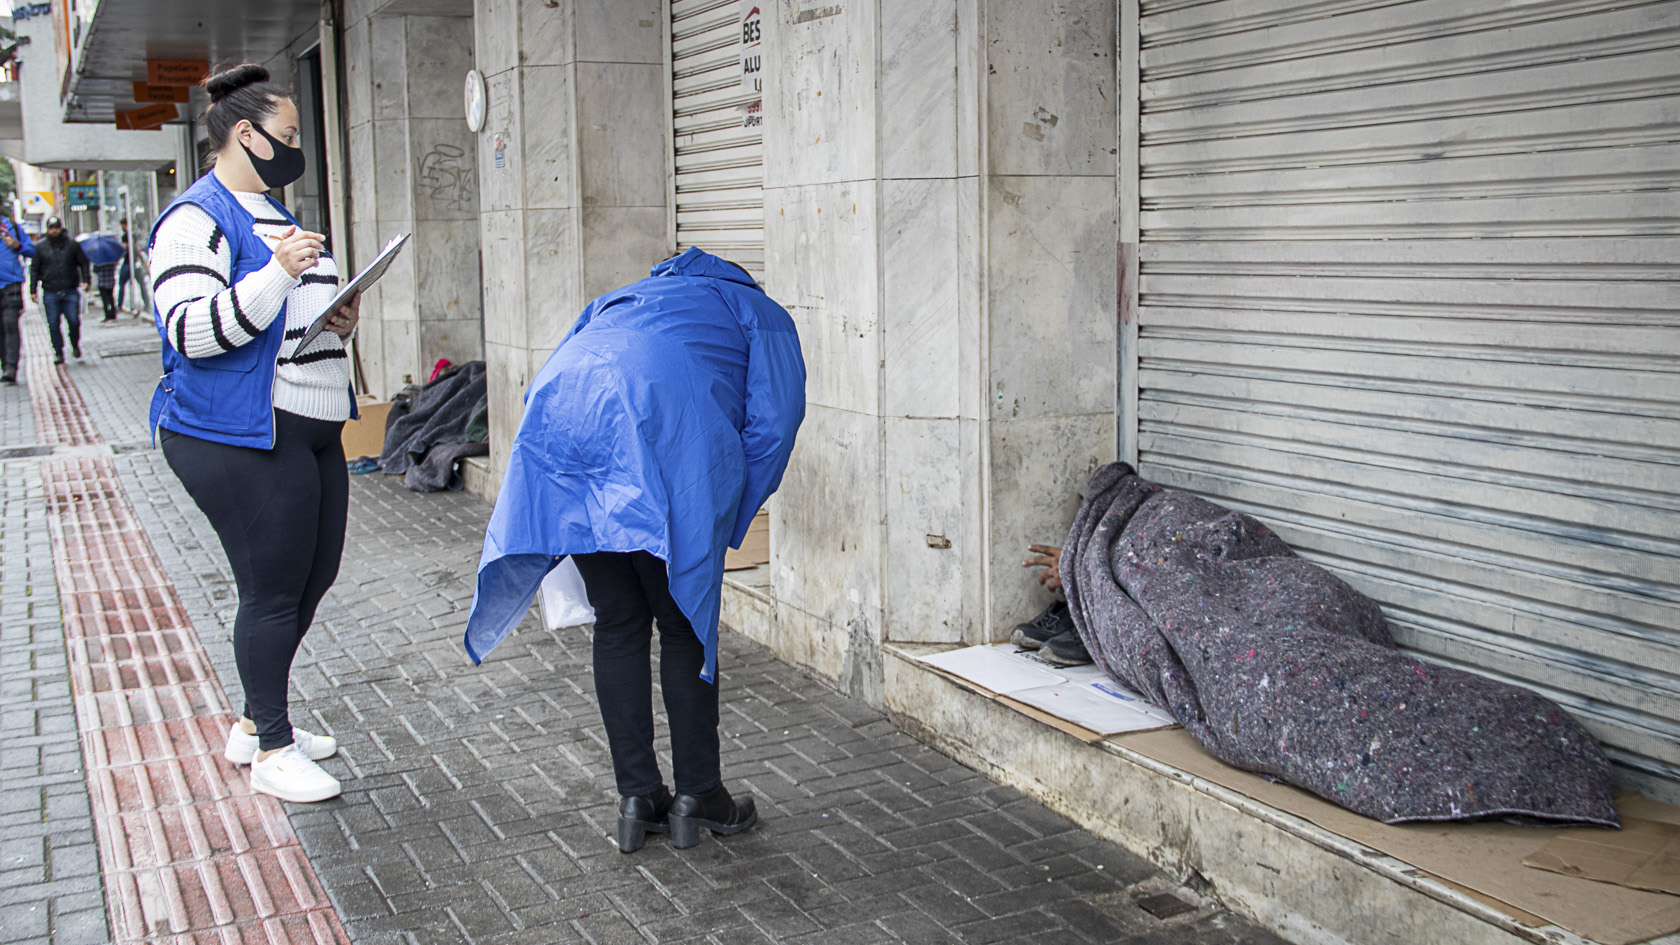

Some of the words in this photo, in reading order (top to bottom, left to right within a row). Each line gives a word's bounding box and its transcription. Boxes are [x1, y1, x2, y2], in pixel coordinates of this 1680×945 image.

[743, 20, 760, 44] BES
[157, 63, 200, 73] Papelaria
[744, 55, 761, 74] ALU
